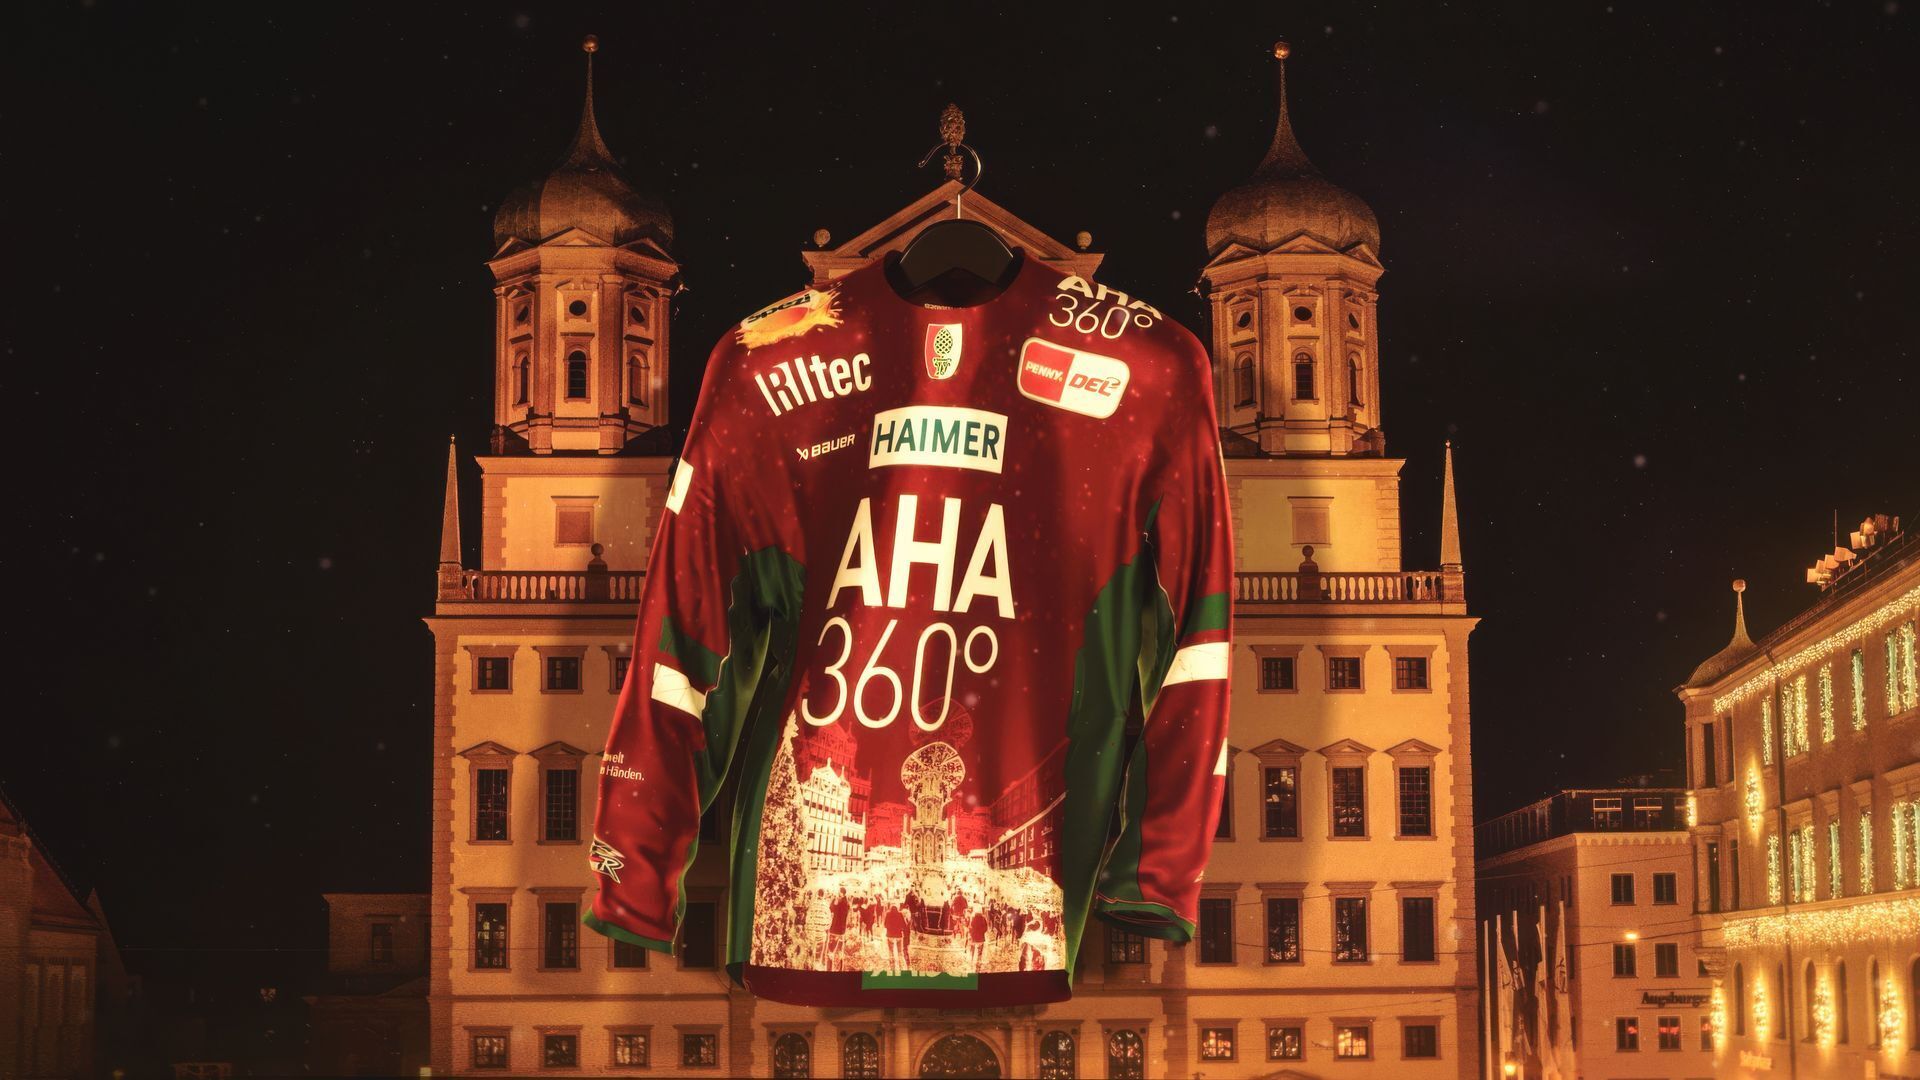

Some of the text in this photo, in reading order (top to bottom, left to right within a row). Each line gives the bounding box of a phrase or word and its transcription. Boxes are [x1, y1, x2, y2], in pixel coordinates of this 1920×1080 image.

[1057, 275, 1162, 320] AHA
[873, 418, 1000, 460] HAIMER
[826, 494, 1016, 620] AHA
[801, 616, 999, 732] 360°
[606, 765, 645, 781] Händen.
